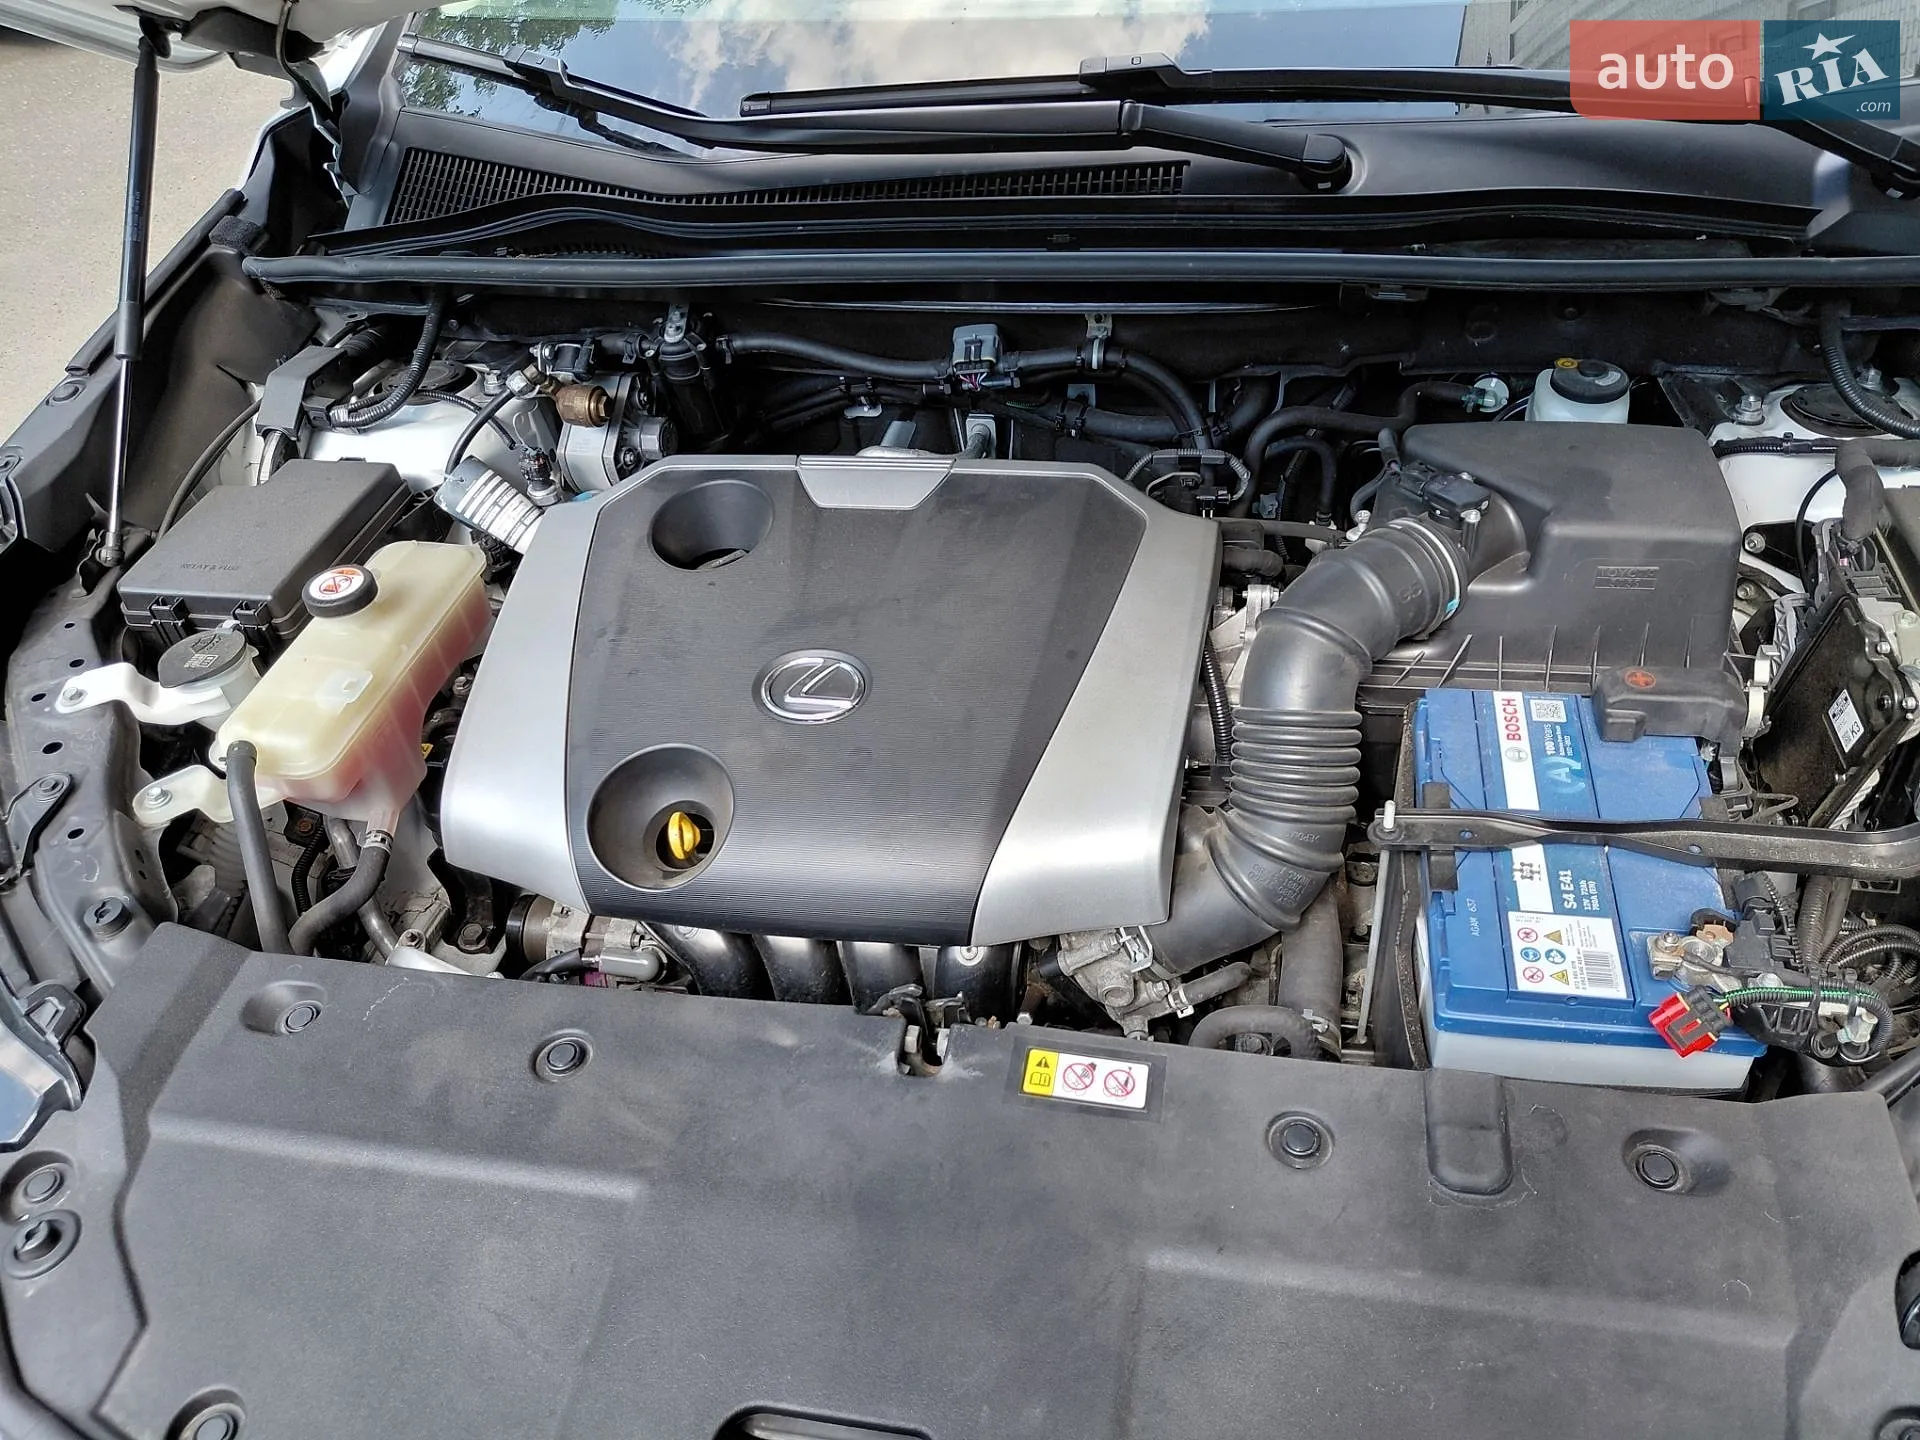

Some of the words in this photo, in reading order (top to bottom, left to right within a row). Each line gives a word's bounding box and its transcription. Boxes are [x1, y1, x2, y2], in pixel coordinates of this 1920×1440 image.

[1501, 698, 1522, 741] BOSCH
[1849, 720, 1861, 738] K3
[1545, 741, 1556, 755] 100
[1558, 869, 1574, 891] E41
[1562, 893, 1577, 909] S4
